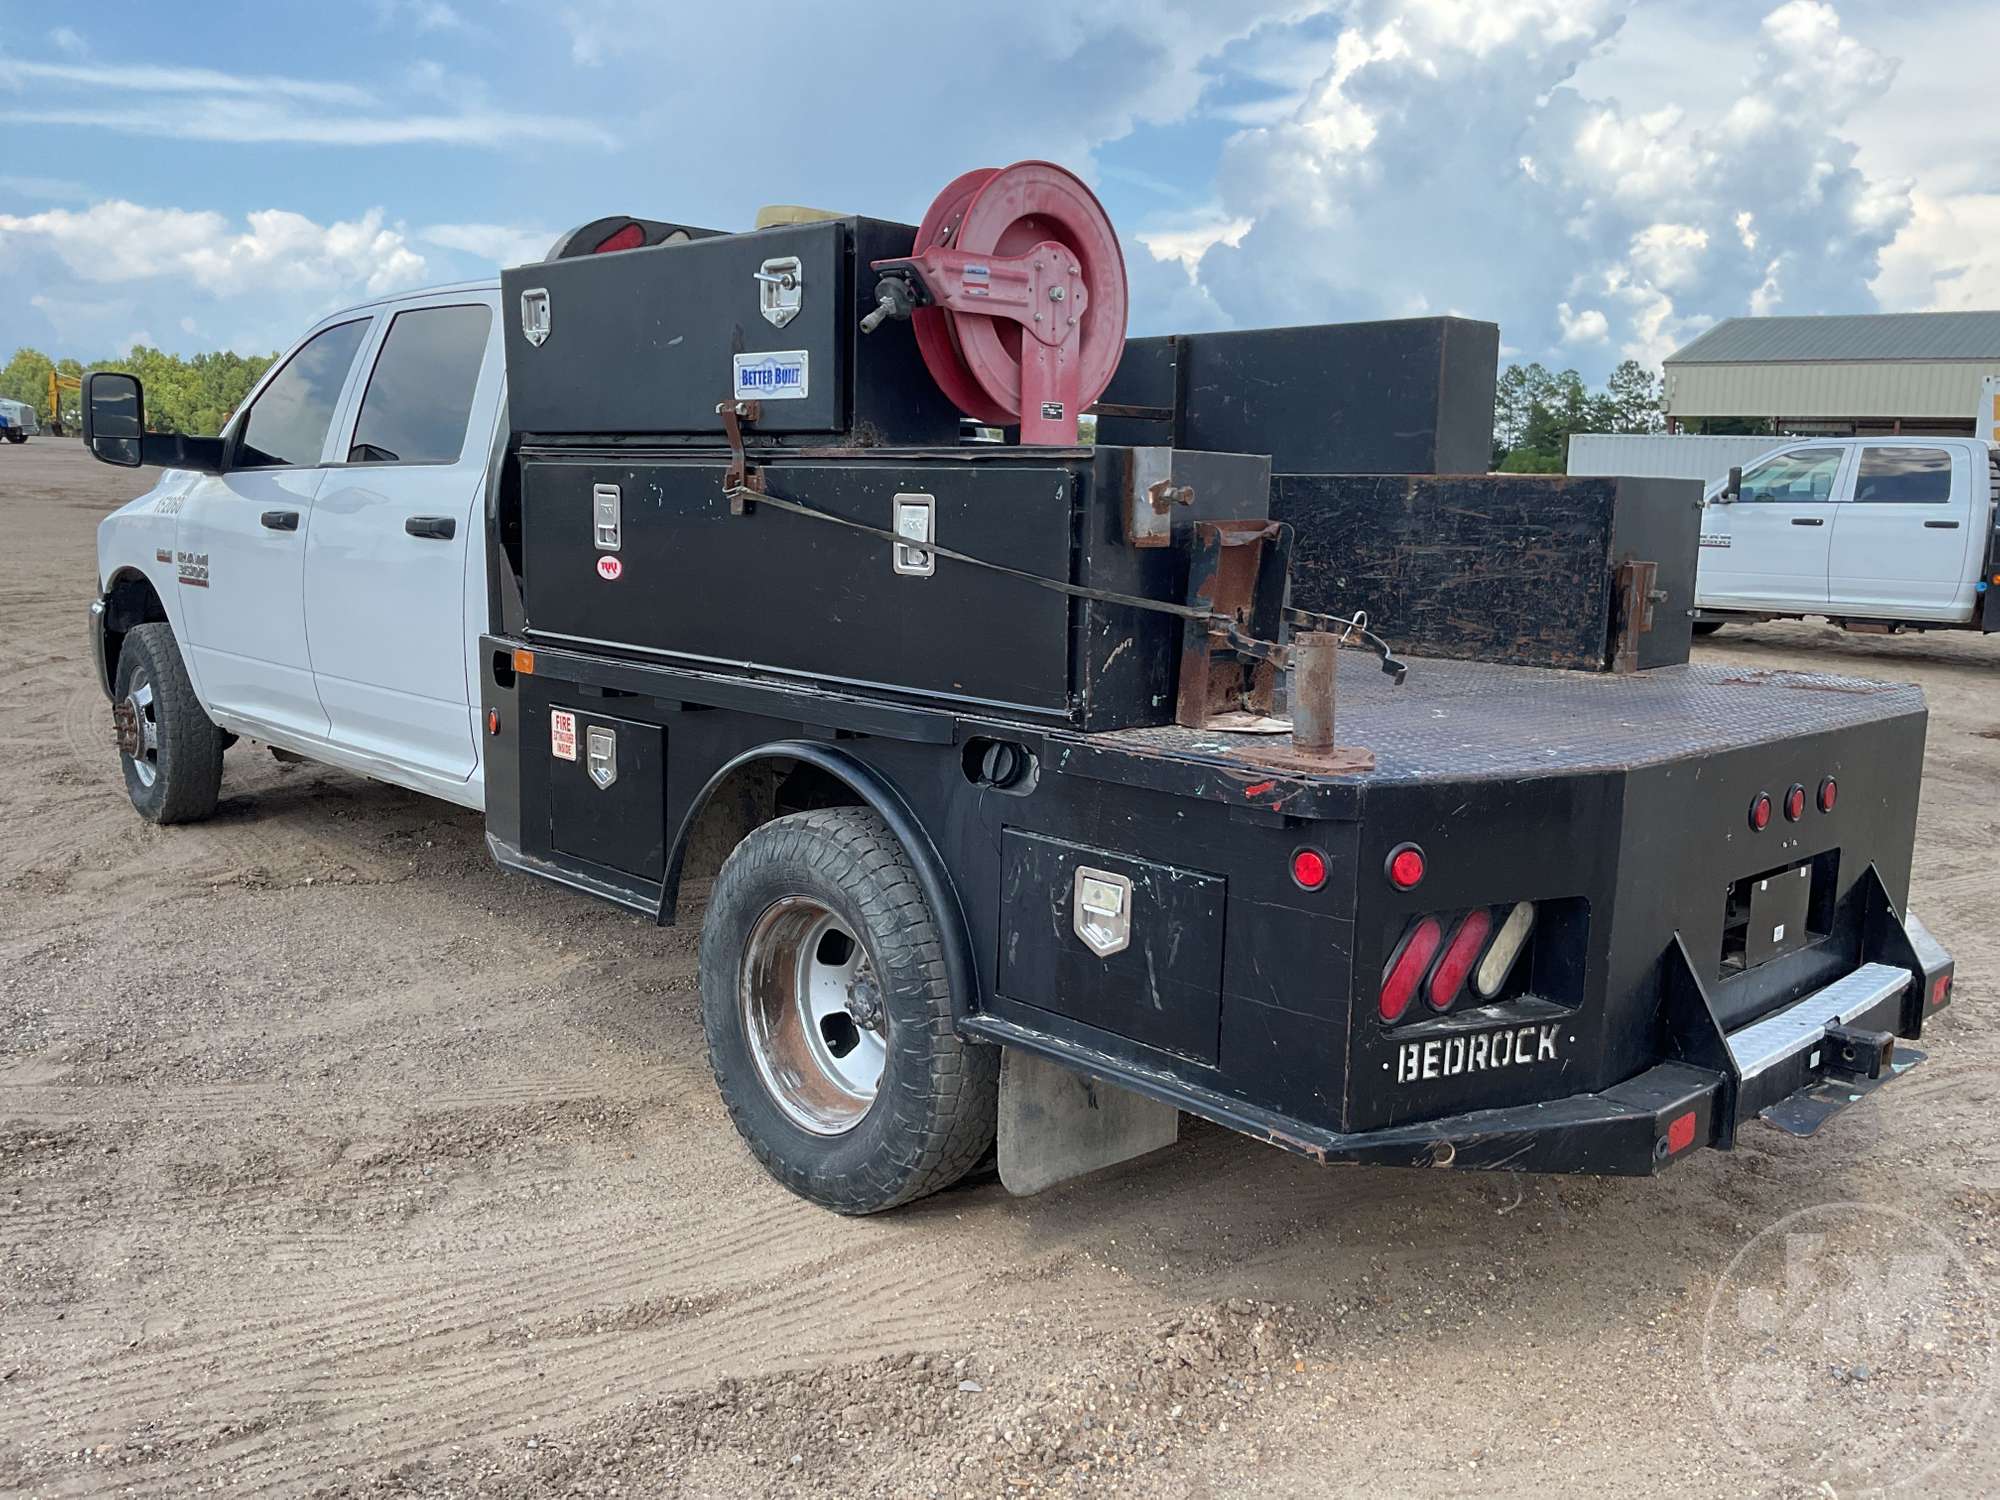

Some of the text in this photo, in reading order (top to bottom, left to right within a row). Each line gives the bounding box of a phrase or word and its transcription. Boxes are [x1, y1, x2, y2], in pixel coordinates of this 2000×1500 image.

[742, 367, 800, 386] BETTER BUILT
[555, 714, 571, 732] FIRE
[1397, 1024, 1561, 1084] BEDROCK
